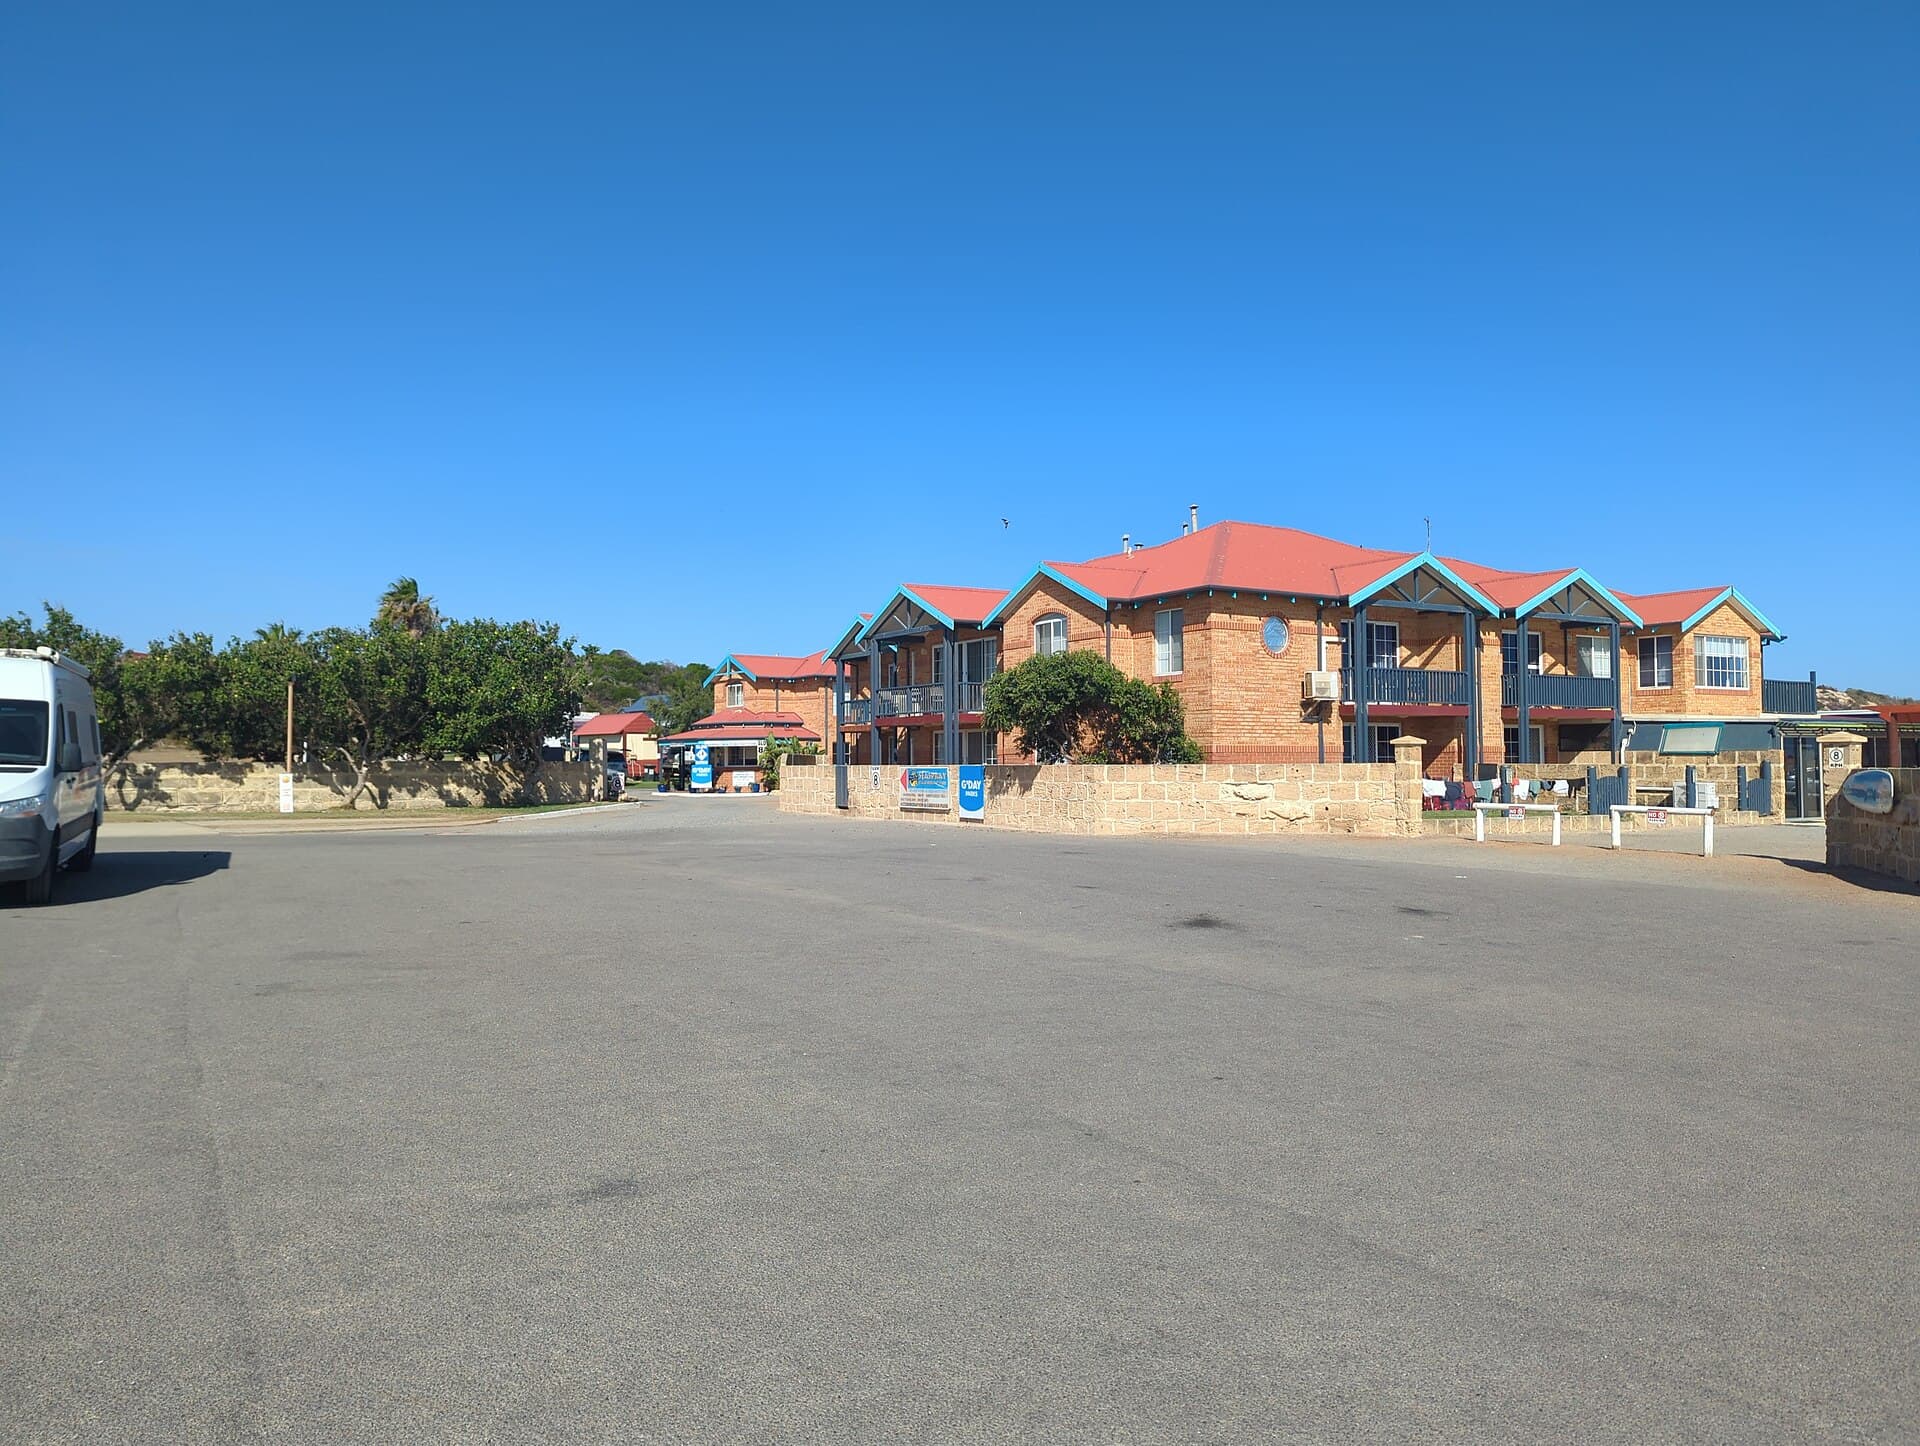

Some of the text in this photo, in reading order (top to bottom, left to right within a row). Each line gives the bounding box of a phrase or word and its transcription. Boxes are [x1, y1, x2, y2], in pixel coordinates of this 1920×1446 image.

[1833, 751, 1840, 760] 8
[614, 779, 622, 788] 8
[873, 774, 879, 786] 8
[961, 779, 982, 790] G'DAY
